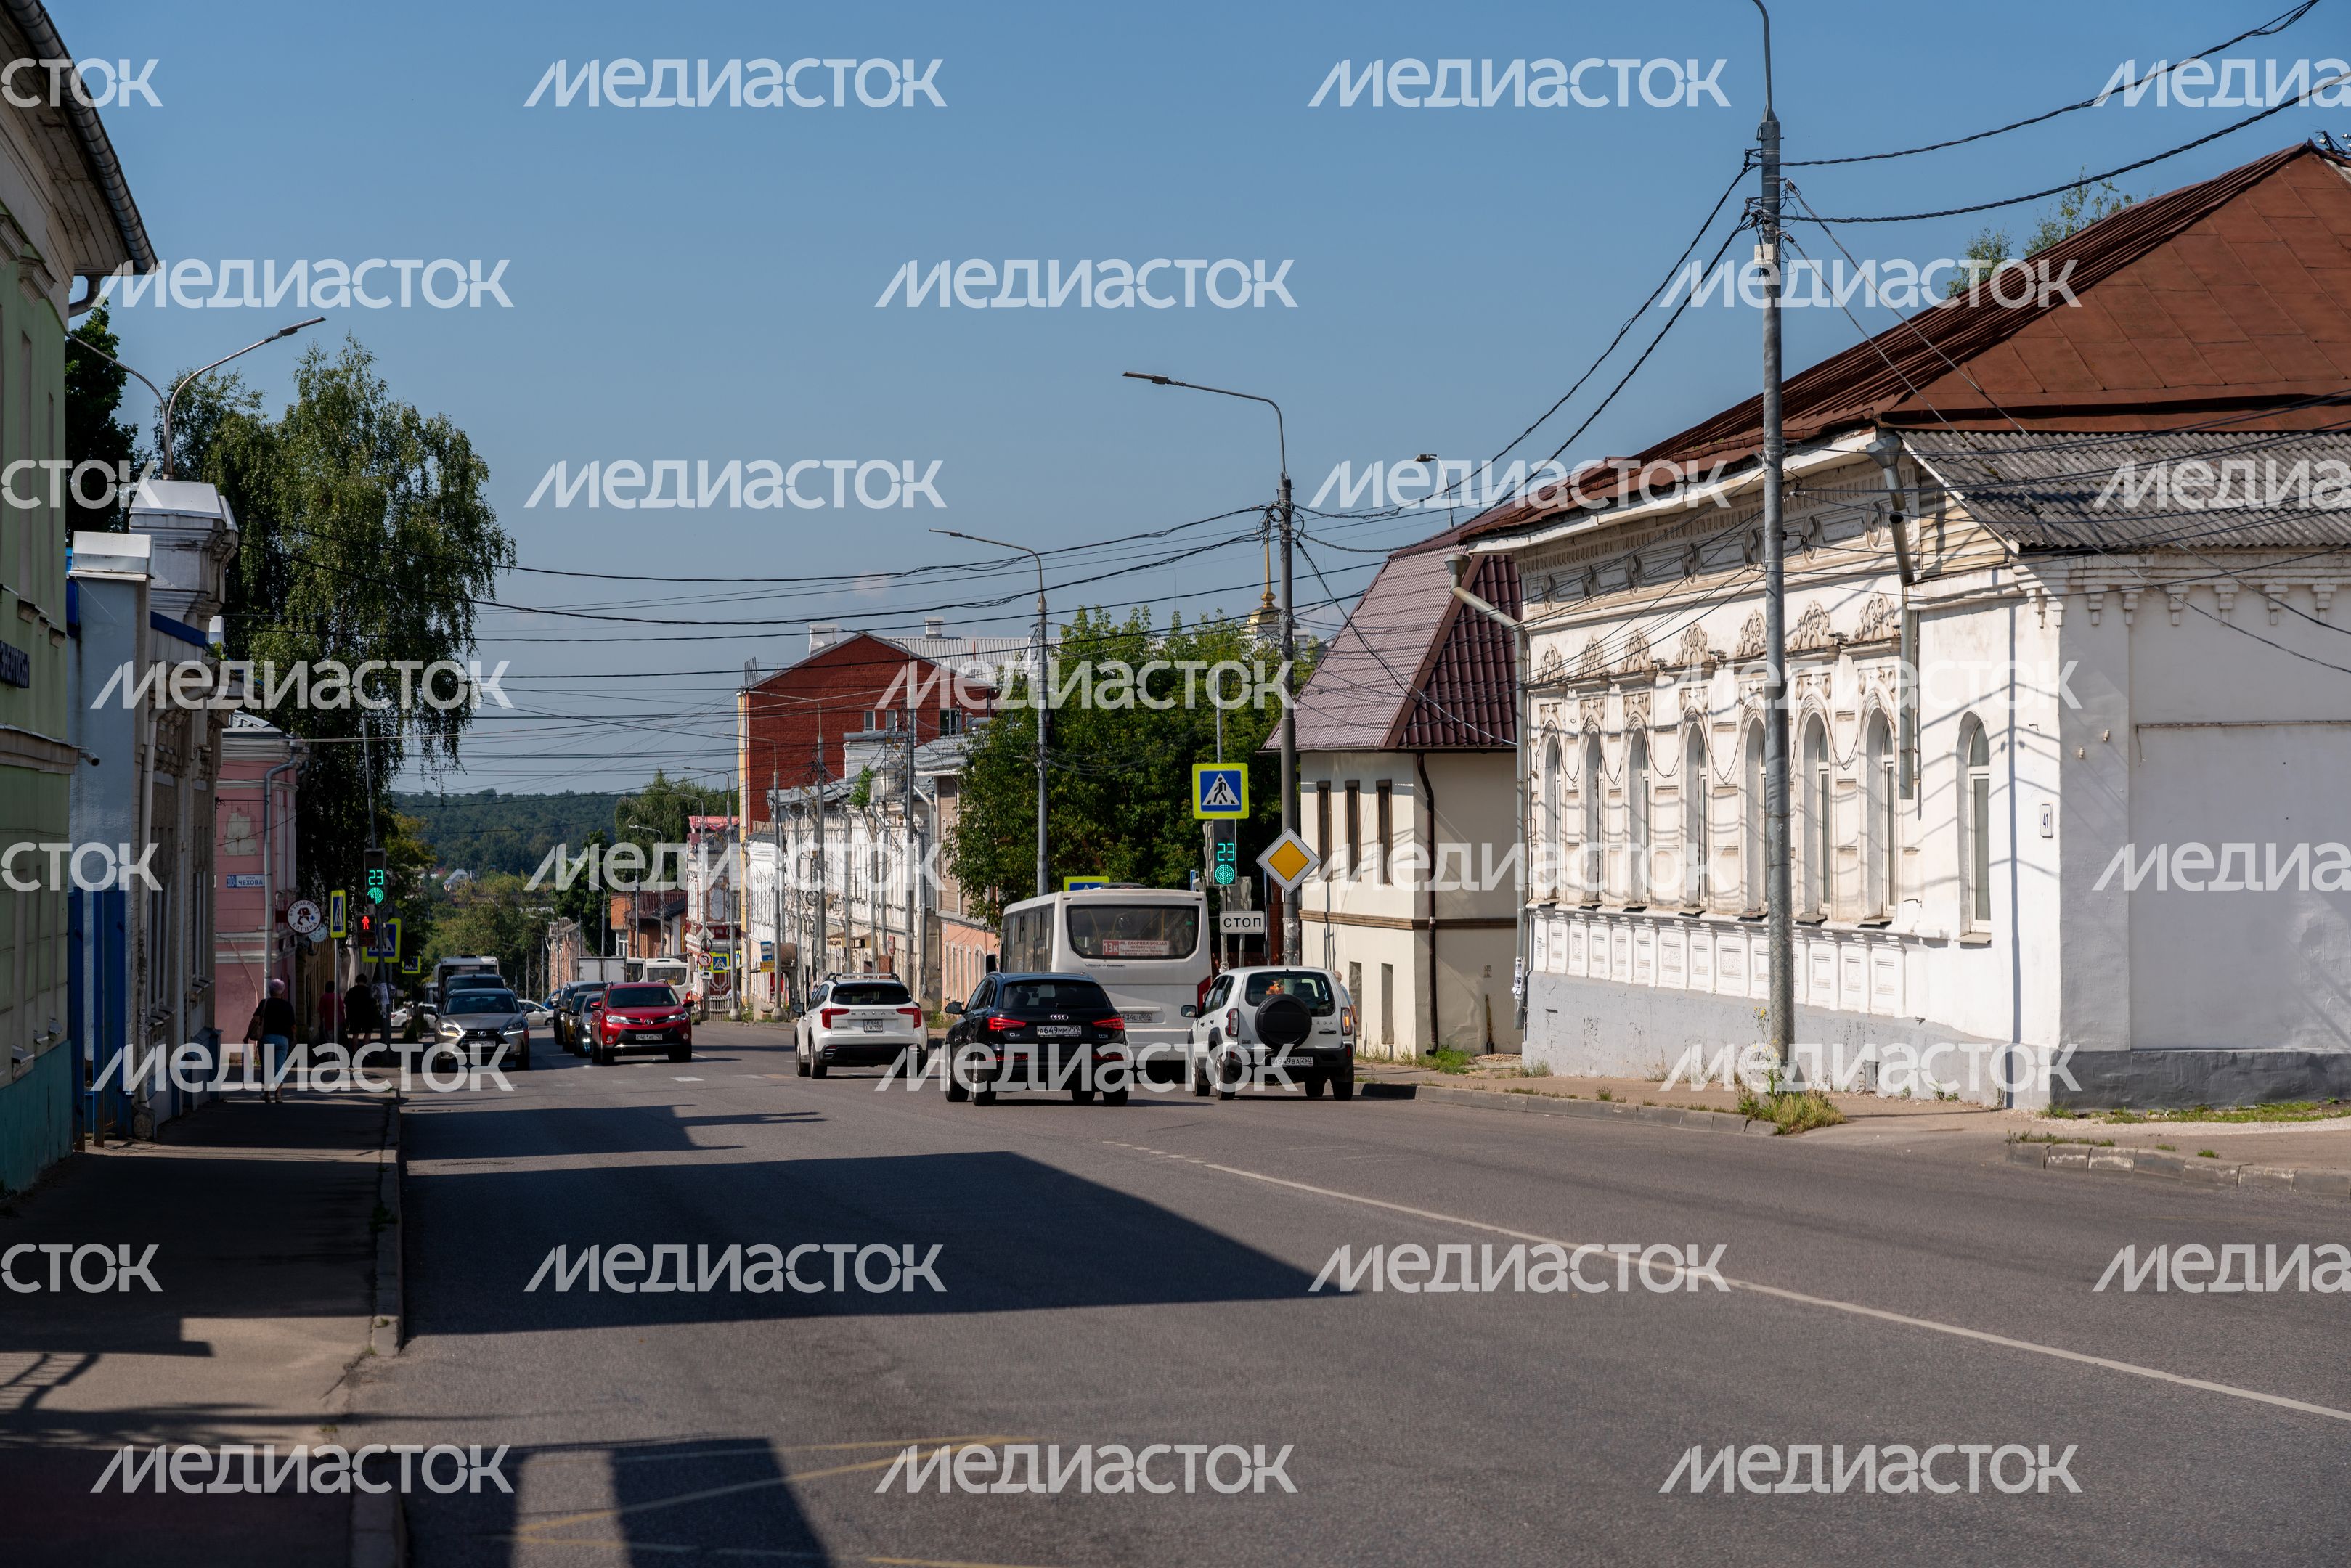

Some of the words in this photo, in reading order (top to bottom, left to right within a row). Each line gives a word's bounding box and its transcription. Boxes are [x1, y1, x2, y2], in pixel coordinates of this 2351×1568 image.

[2043, 813, 2048, 828] 41
[1218, 843, 1235, 861] 23
[369, 870, 383, 885] 23
[1223, 918, 1261, 928] СТОП
